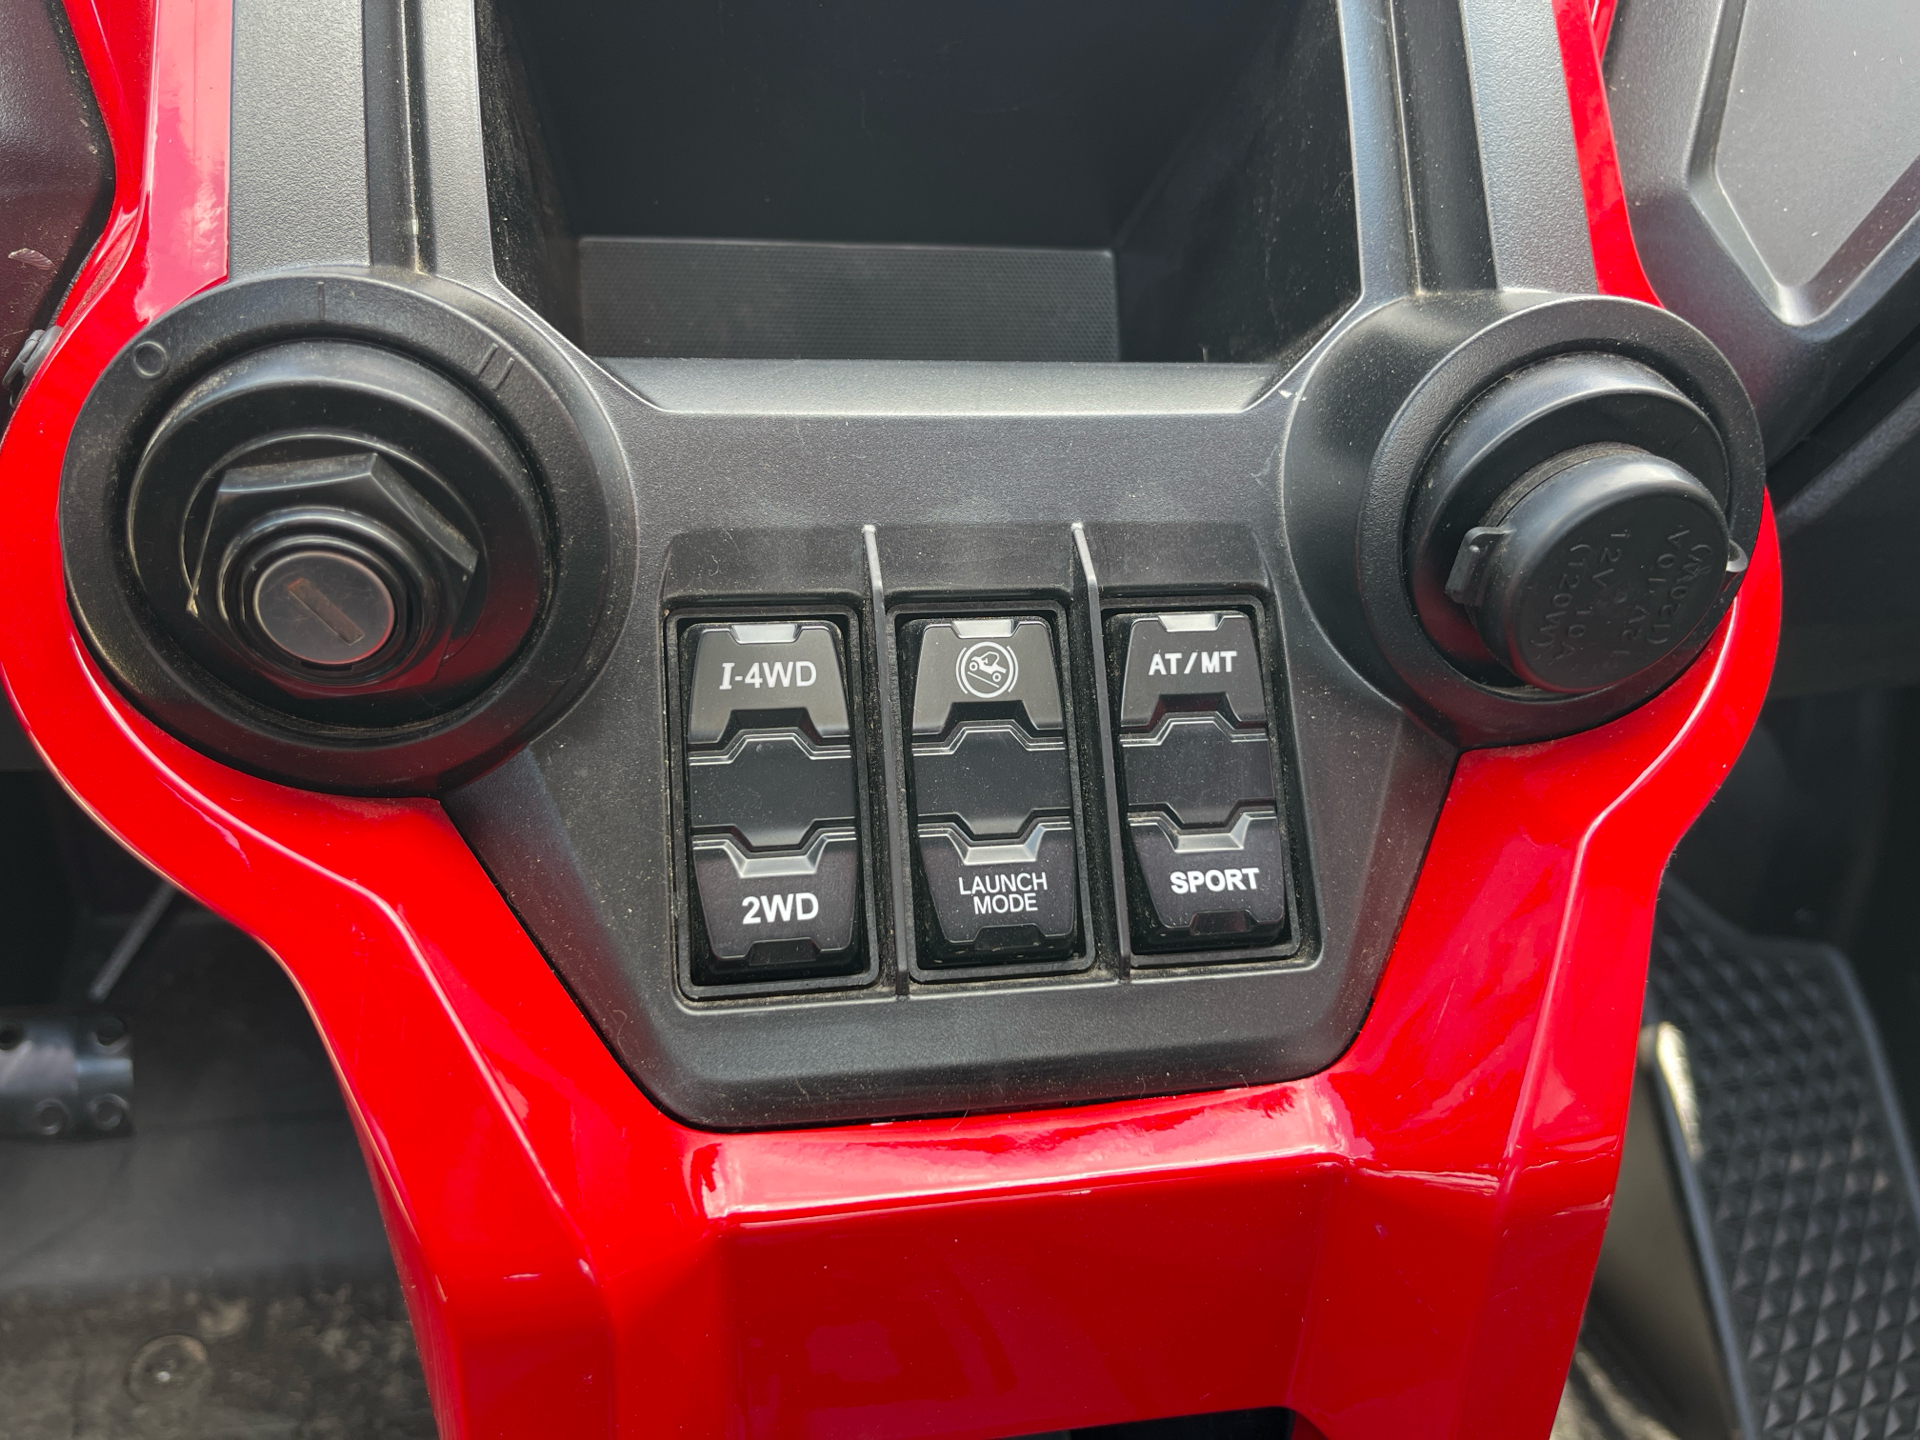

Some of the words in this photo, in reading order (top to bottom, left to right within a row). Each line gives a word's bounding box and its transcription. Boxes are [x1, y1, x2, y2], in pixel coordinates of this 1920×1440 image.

[1591, 528, 1633, 588] 12V
[1530, 543, 1594, 648] (120W)
[1548, 605, 1594, 665] 10A
[718, 660, 818, 692] I-4WD
[1148, 650, 1238, 677] AT/MT
[958, 872, 1048, 897] LAUNCH
[1169, 867, 1261, 895] SPORT
[741, 892, 820, 925] 2WD
[973, 892, 1039, 915] MODE
